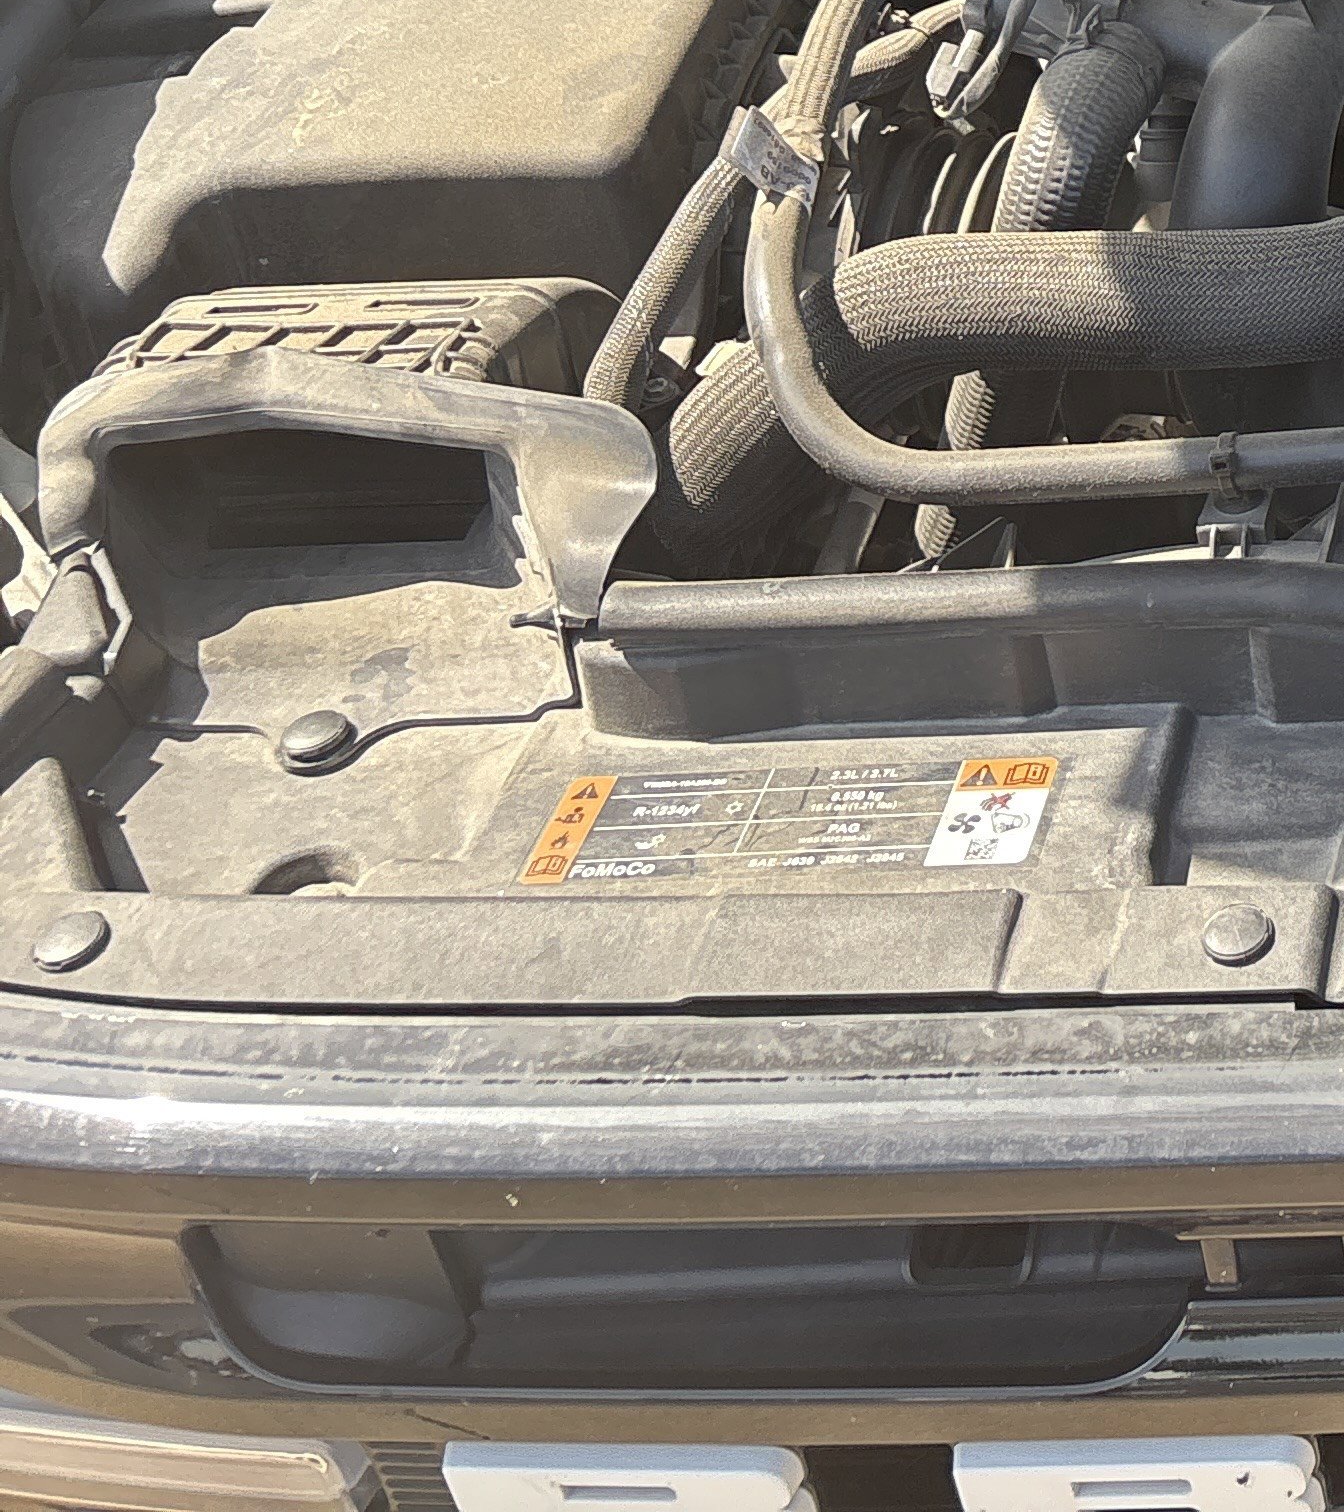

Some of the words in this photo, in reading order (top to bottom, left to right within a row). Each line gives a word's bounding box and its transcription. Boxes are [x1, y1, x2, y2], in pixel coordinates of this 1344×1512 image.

[829, 769, 858, 781] 2.3L
[869, 767, 899, 779] 2.7L
[826, 822, 861, 834] PAG
[567, 861, 657, 879] FoMoCo
